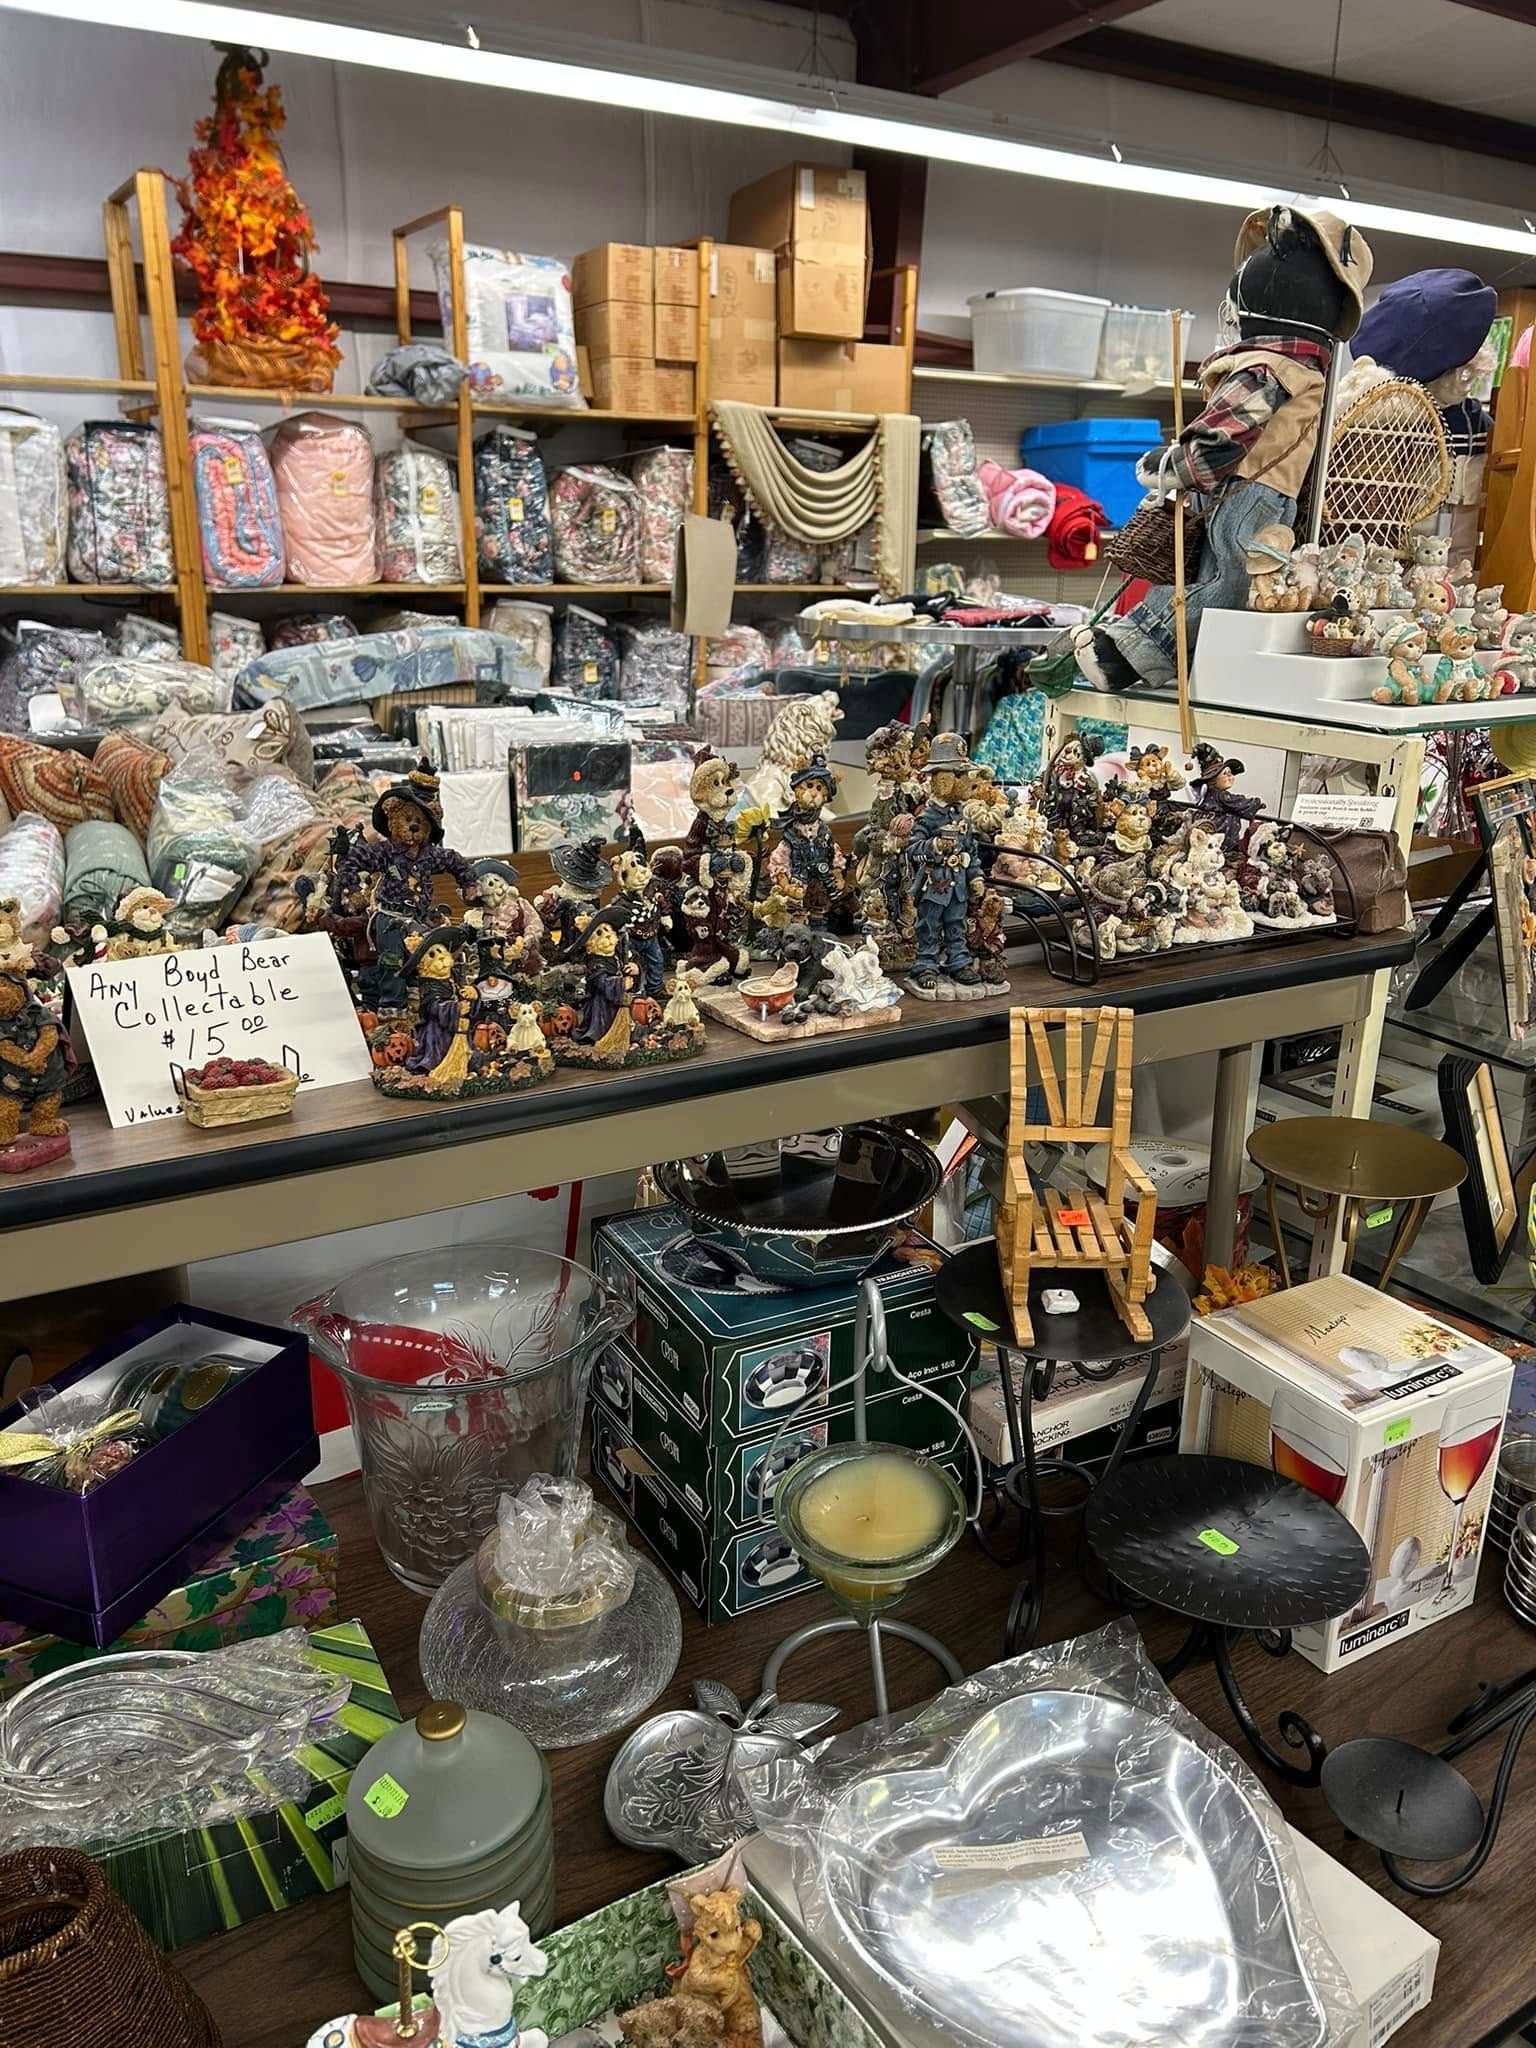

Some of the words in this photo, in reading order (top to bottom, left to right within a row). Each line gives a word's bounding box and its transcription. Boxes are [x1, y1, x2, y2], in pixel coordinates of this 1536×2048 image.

[164, 955, 220, 992] Boyd
[242, 947, 291, 971] Bear
[114, 978, 300, 1030] Collectable
[910, 1307, 932, 1320] Cesta
[902, 1393, 923, 1406] Cesta
[1383, 1367, 1448, 1399] luminarc
[1341, 1618, 1399, 1653] luminarc
